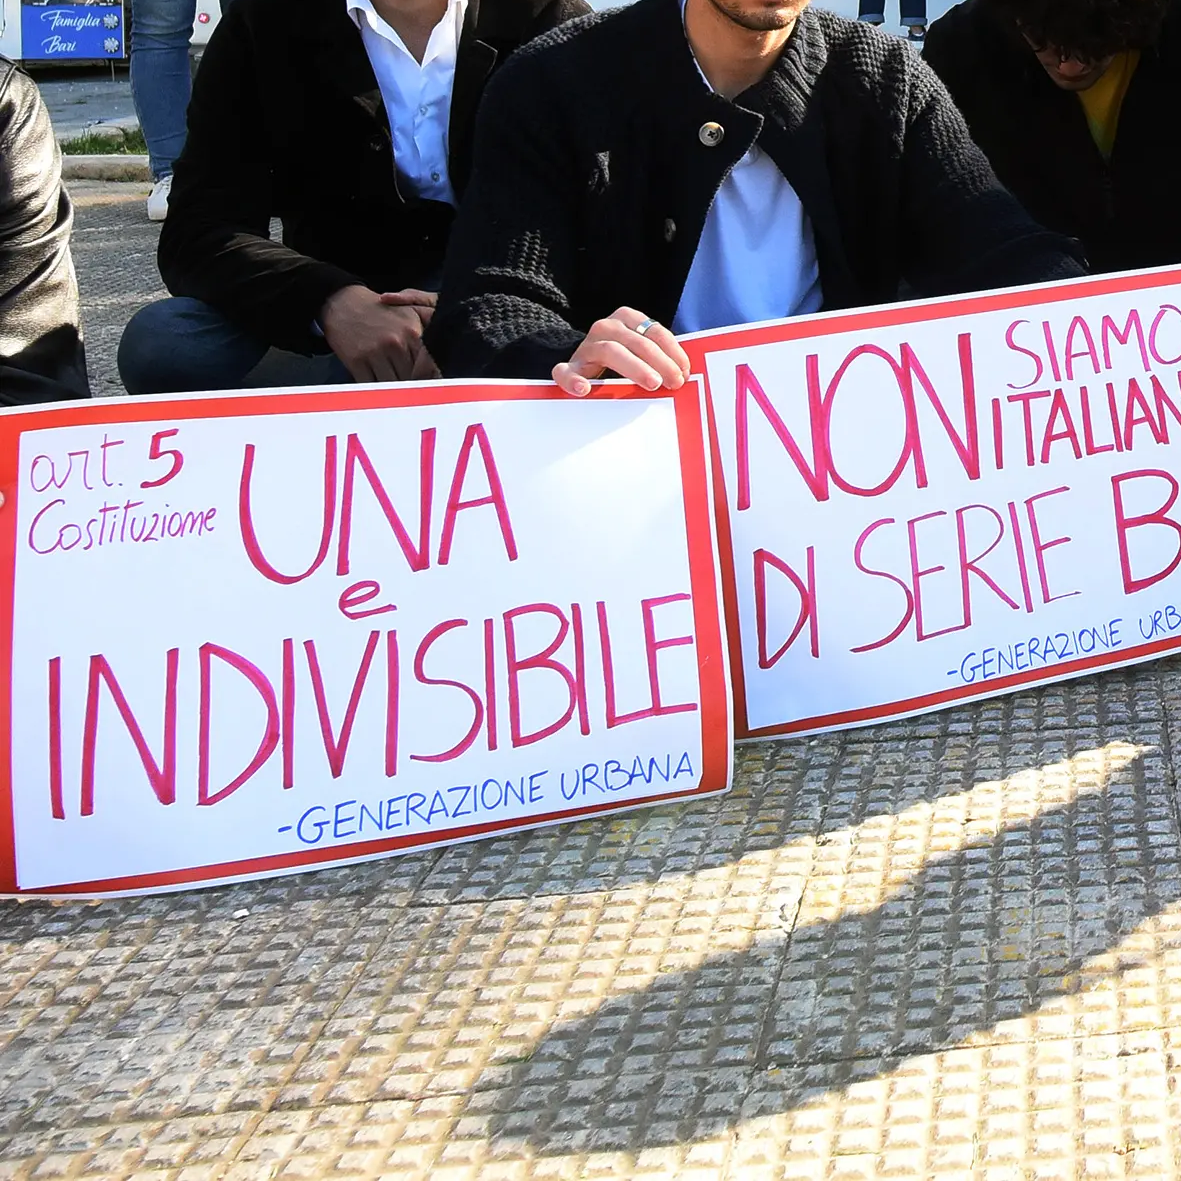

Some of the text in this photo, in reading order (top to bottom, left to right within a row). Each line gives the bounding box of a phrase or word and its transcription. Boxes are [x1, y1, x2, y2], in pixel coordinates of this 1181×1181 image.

[40, 9, 101, 32] Famiglia
[41, 35, 77, 55] Bari
[735, 332, 980, 511] NON
[30, 428, 185, 492] art. 5
[27, 498, 217, 555] Costituzione
[239, 422, 519, 585] UNA
[339, 580, 397, 620] e
[753, 545, 820, 670] DI
[850, 485, 1082, 654] SERIE
[946, 619, 1123, 683] -GENERAZIONE
[49, 593, 698, 821] INDIVISIBILE
[277, 751, 695, 845] -GENERAZIONE URBANA
